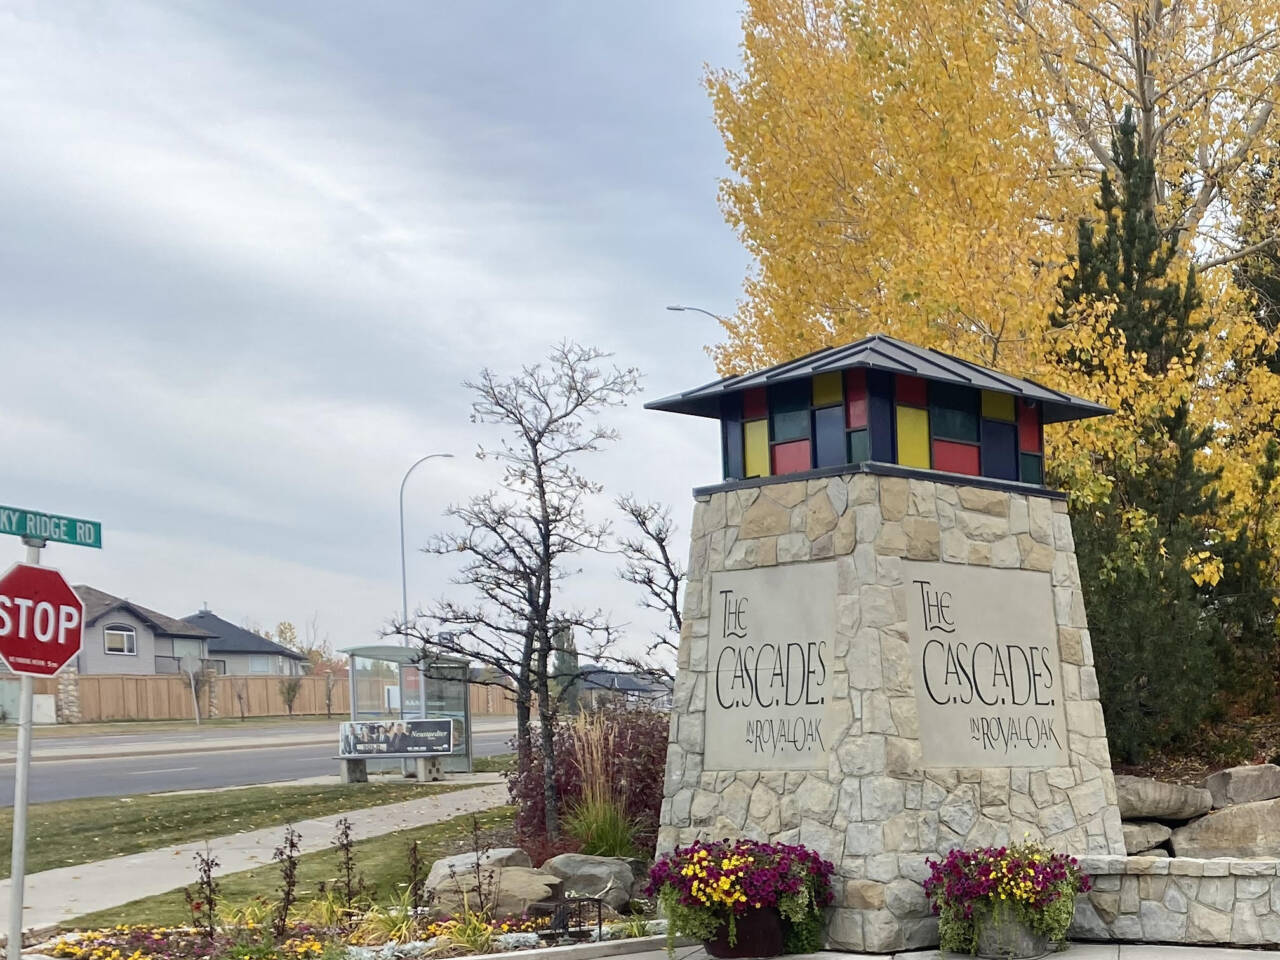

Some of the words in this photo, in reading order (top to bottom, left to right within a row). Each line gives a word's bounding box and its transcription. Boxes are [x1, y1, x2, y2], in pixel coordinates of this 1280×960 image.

[26, 513, 68, 540] RIDGE
[76, 521, 95, 543] RD
[0, 595, 80, 643] STOP
[719, 590, 748, 638] THE
[913, 580, 955, 631] THE
[716, 641, 827, 709] CASCADES
[923, 639, 1055, 706] CASCADES
[746, 719, 755, 737] IN
[970, 716, 980, 734] IN
